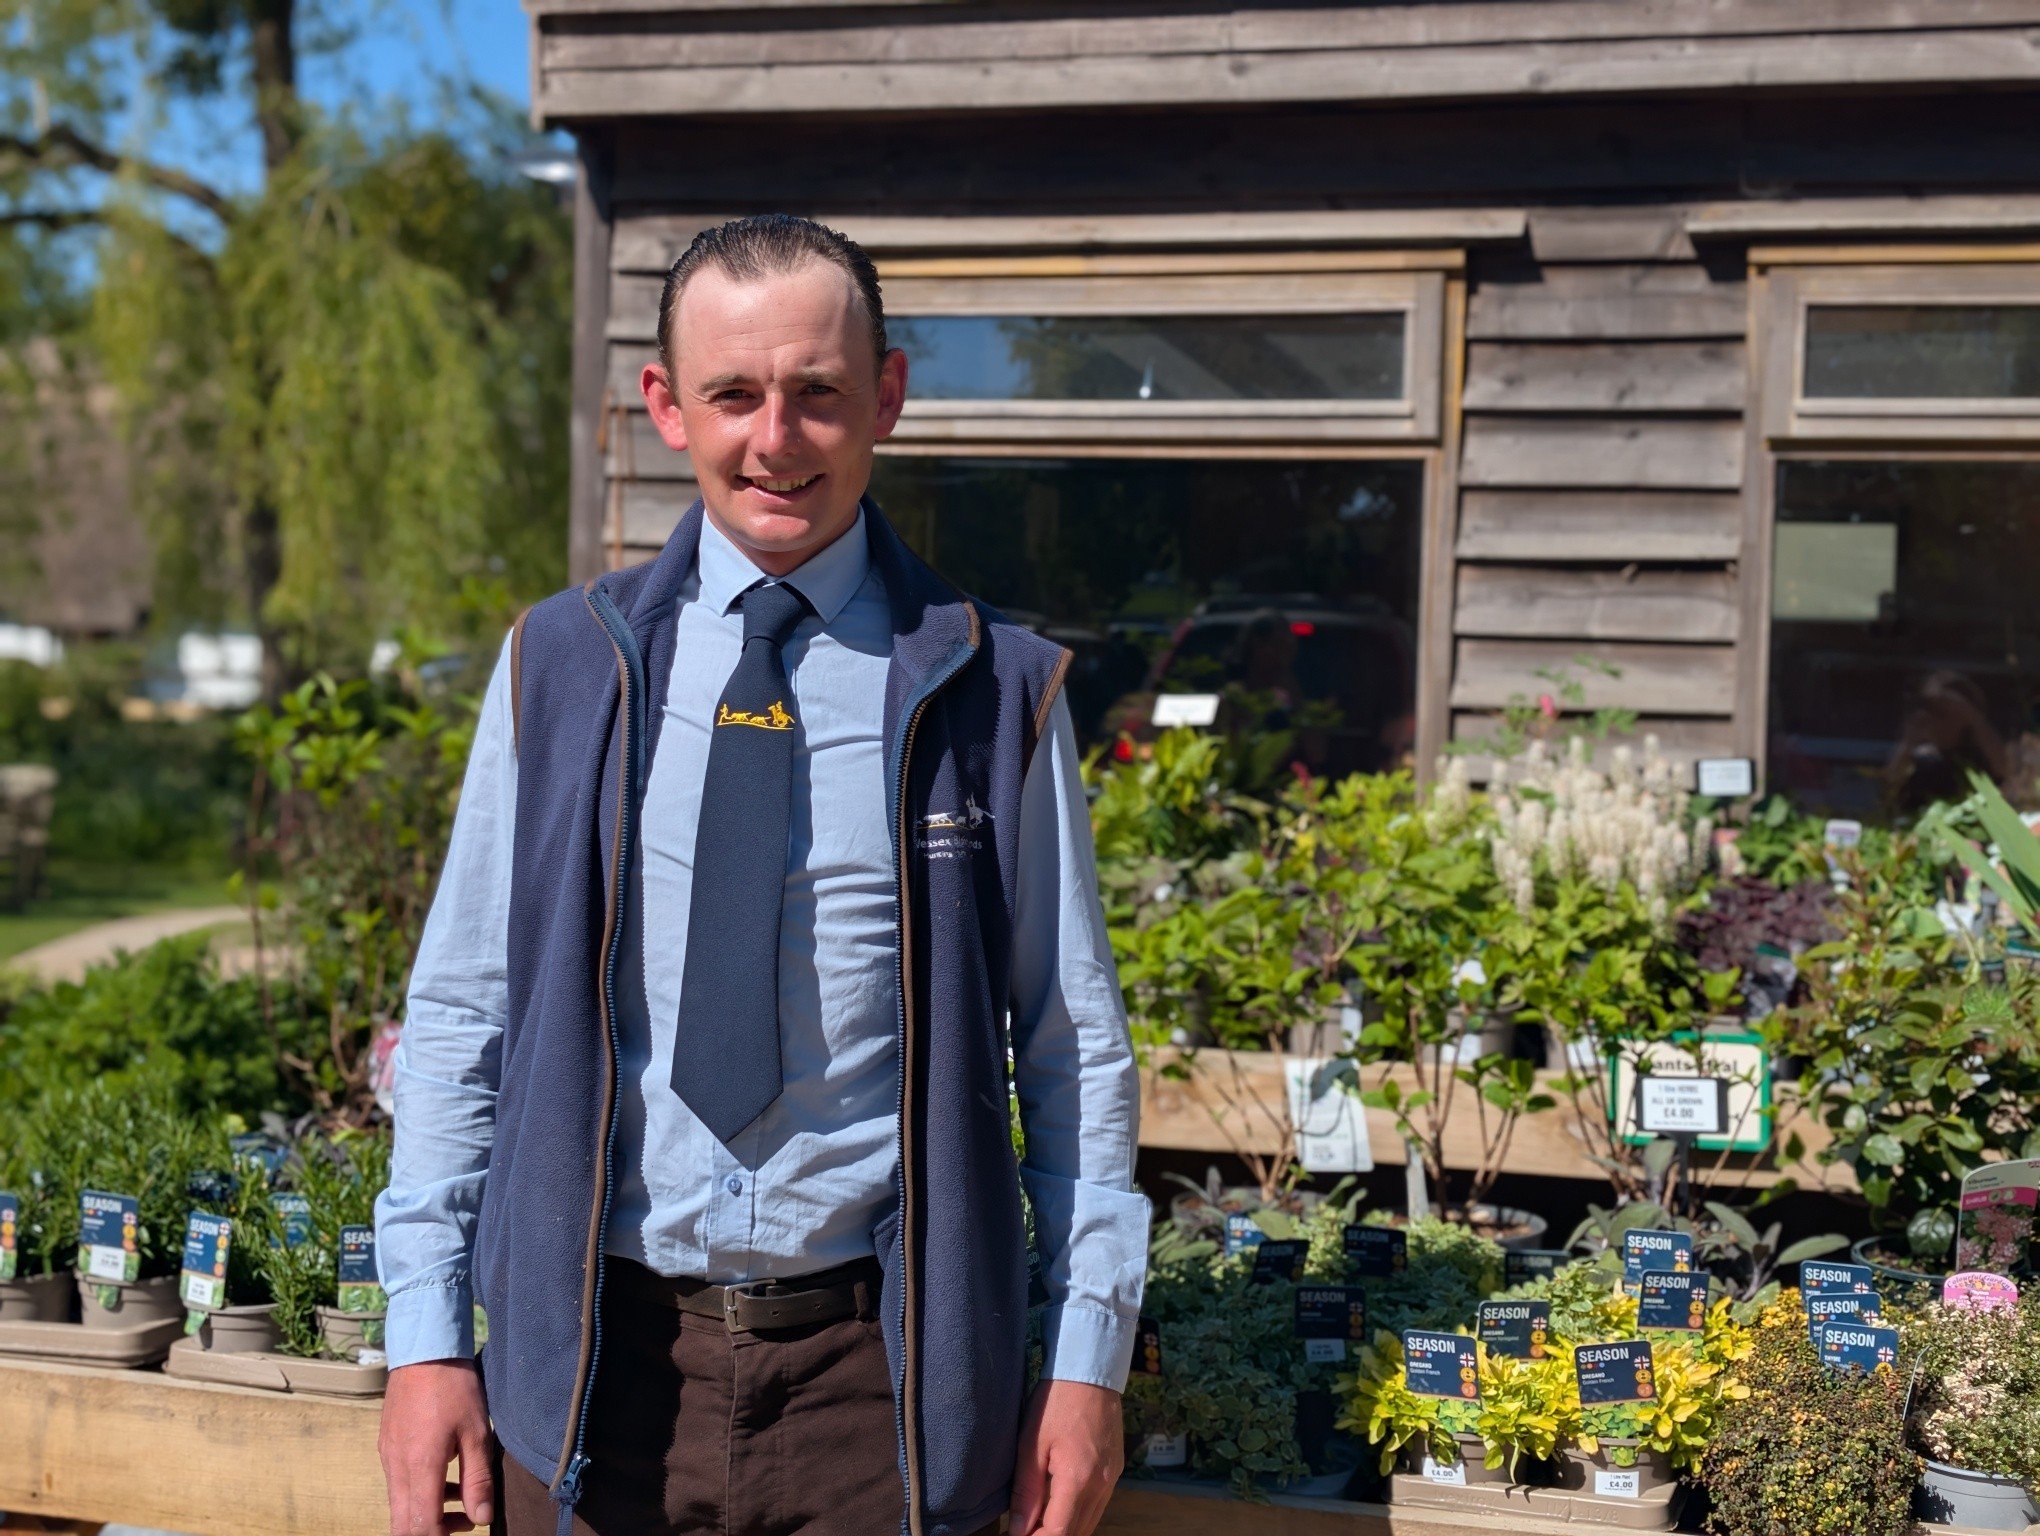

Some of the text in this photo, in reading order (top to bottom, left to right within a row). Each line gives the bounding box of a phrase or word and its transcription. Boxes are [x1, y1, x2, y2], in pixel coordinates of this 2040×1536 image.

[83, 1196, 122, 1213] SEASON
[190, 1218, 219, 1235] SEASON
[343, 1231, 374, 1245] SEAS
[1347, 1230, 1389, 1244] SEASON
[1627, 1235, 1672, 1250] SEASON
[1645, 1275, 1690, 1289] SEASON
[1805, 1268, 1851, 1283] SEASON
[1300, 1291, 1346, 1303] SEASON
[1484, 1307, 1530, 1320] SEASON
[1812, 1301, 1859, 1314] SEASON
[1407, 1337, 1455, 1353] SEASON
[1825, 1330, 1875, 1347] SEASON
[1578, 1348, 1629, 1363] SEASON
[1409, 1361, 1432, 1369] OREGANO
[1432, 1469, 1454, 1477] £4.00
